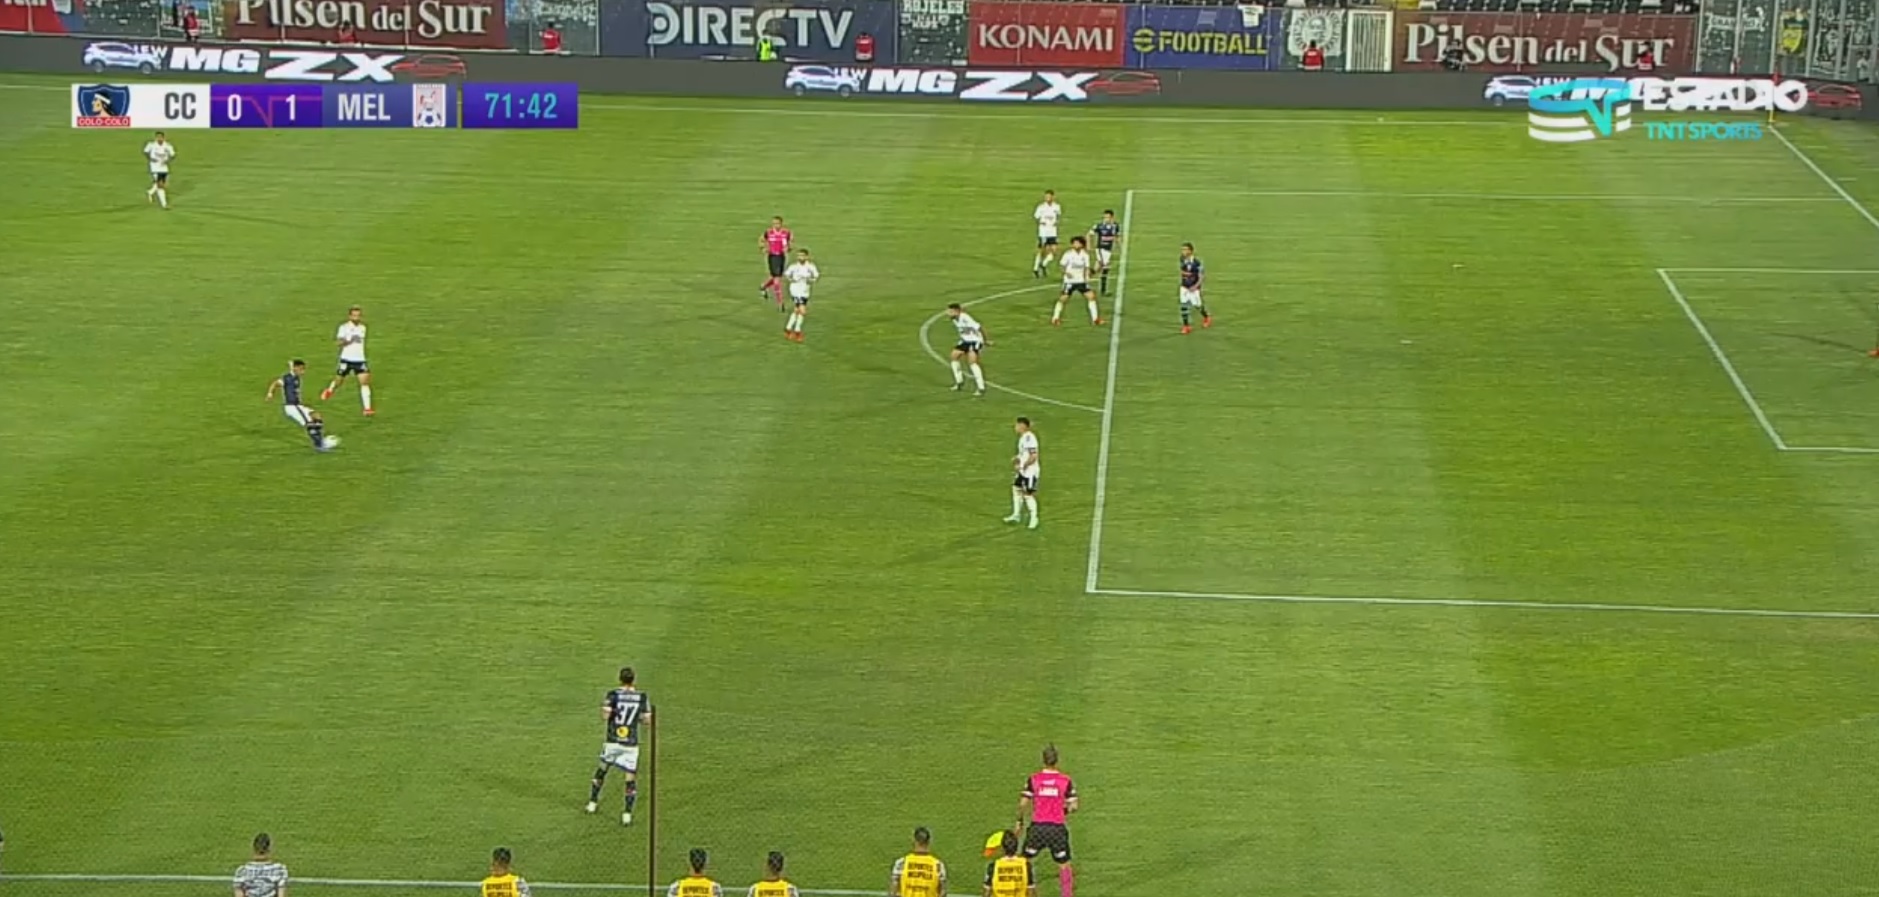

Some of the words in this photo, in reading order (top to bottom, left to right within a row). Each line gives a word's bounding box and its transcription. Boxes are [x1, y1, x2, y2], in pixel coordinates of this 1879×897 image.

[372, 5, 411, 31] del
[418, 0, 491, 38] Sur
[647, 2, 854, 49] DIRECTV
[979, 23, 1114, 52] KONAMI
[1545, 39, 1586, 63] del
[1595, 34, 1674, 73] Sur
[170, 47, 260, 73] MG
[265, 50, 405, 83] ZX
[868, 69, 957, 93] MG
[960, 71, 1099, 100] ZX
[614, 702, 640, 726] 37
